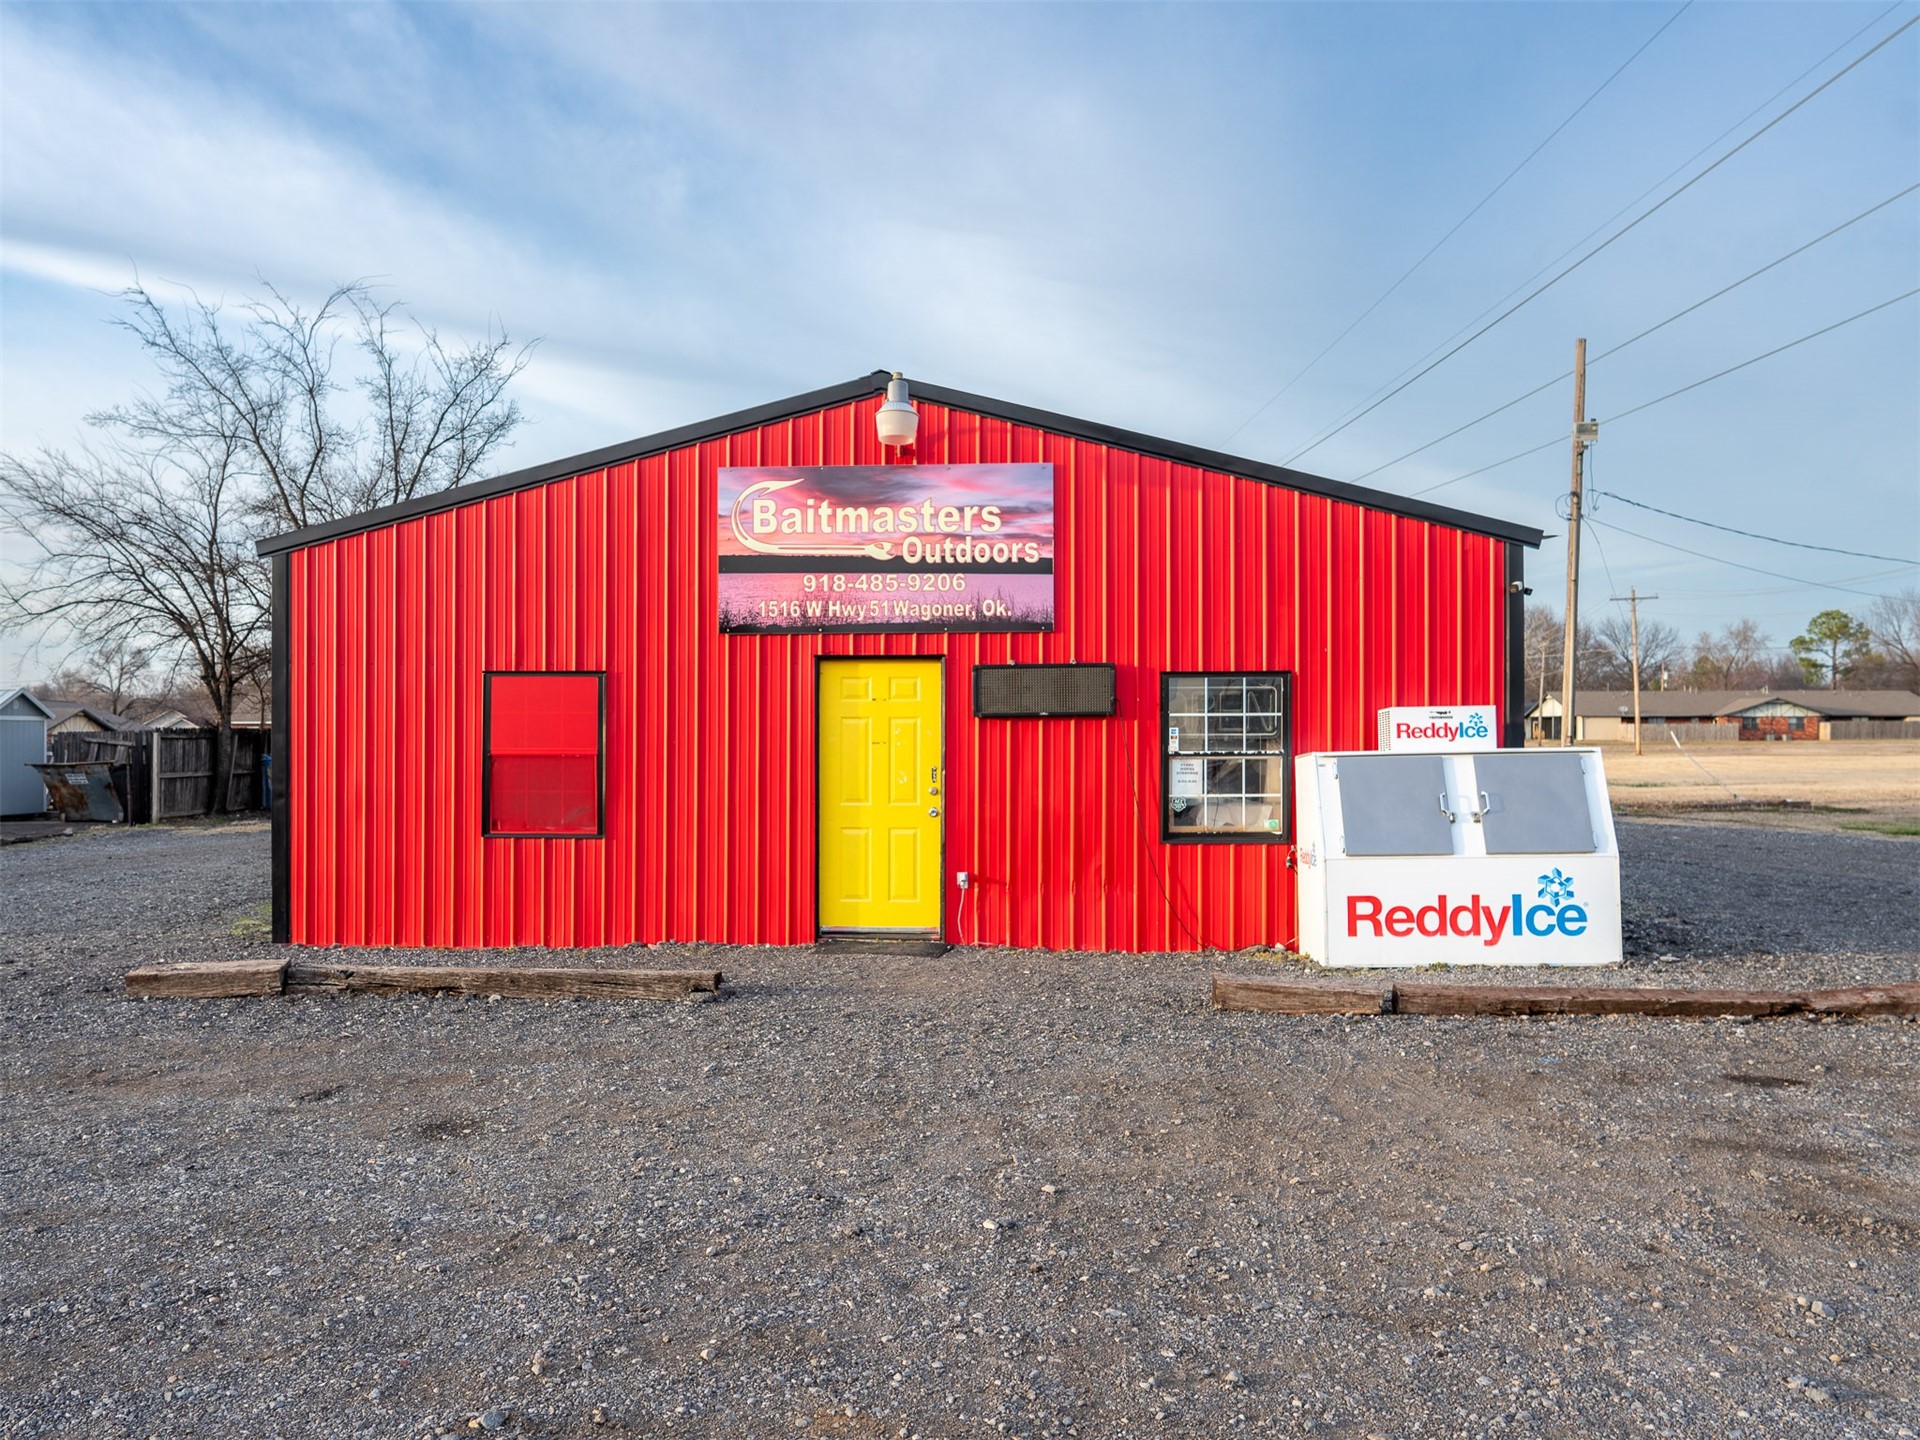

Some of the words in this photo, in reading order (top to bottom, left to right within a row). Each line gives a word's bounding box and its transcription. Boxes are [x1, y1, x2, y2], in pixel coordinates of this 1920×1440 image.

[752, 498, 1002, 535] Baitmasters
[901, 536, 1040, 564] Outdoors
[802, 573, 967, 593] 918-485-9206
[758, 600, 800, 618] 1516
[806, 600, 822, 617] W
[828, 600, 867, 621] Hwy
[870, 600, 889, 616] 51
[892, 599, 977, 621] Wagoner,
[982, 599, 1012, 617] Ok.
[1396, 722, 1488, 742] ReddyIce
[1347, 894, 1588, 946] ReddyIce
